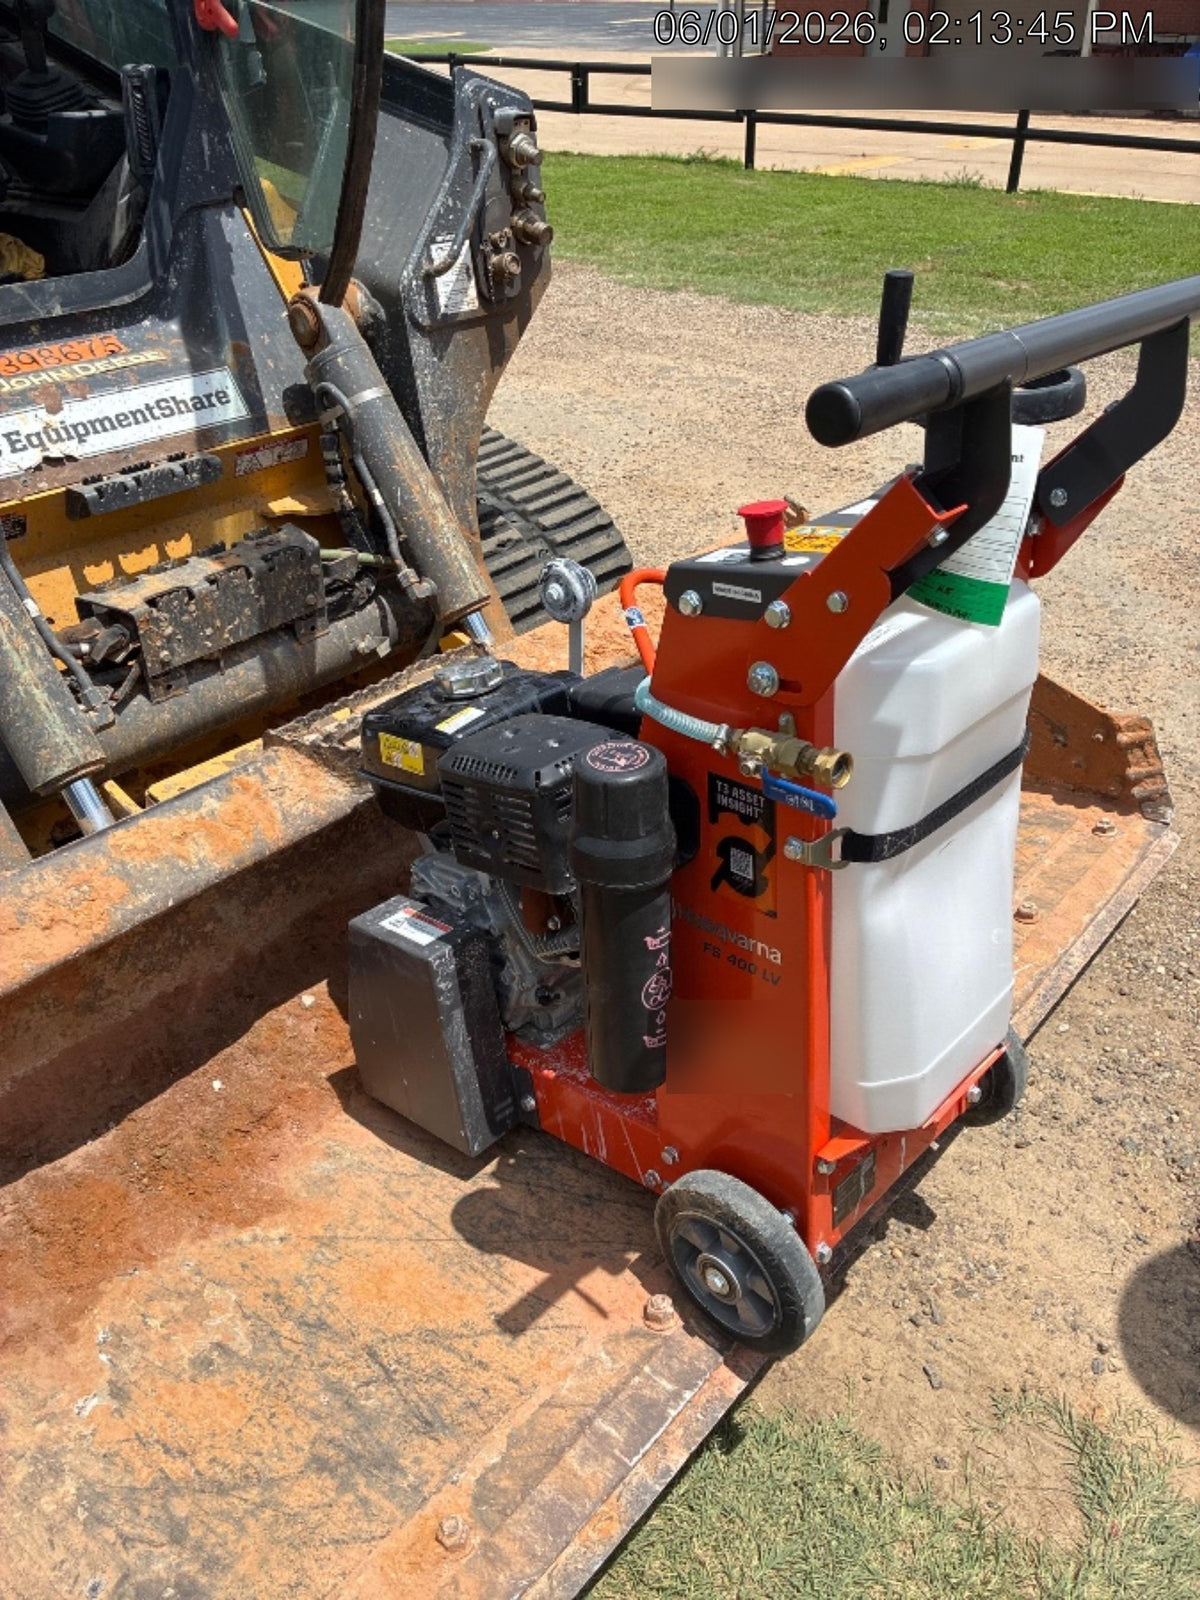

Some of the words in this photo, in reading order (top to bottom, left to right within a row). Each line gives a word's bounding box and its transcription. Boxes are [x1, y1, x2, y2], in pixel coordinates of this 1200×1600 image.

[1, 388, 232, 455] EquipmentShare
[716, 780, 729, 795] T3
[731, 785, 765, 809] ASSET
[727, 953, 758, 976] 400
[762, 967, 782, 986] LV
